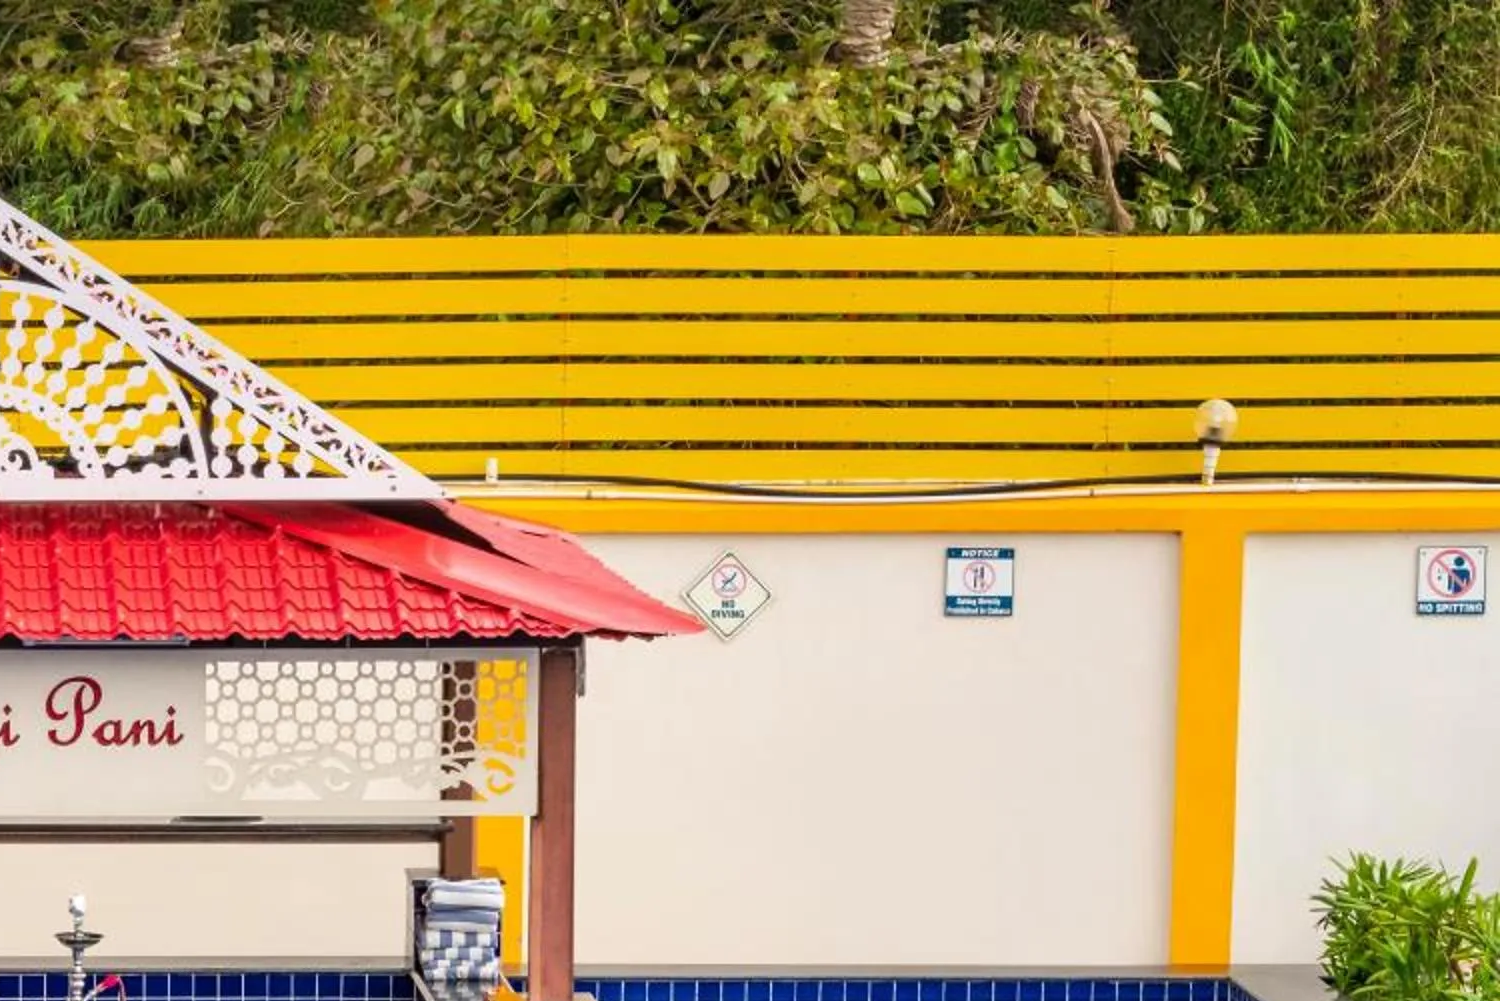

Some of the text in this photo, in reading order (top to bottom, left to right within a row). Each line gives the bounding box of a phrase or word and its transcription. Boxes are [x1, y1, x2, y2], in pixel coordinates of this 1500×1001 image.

[721, 600, 736, 608] NO
[1419, 604, 1483, 612] NO SPITTING
[711, 610, 745, 618] DIVING
[44, 675, 185, 748] Pani
